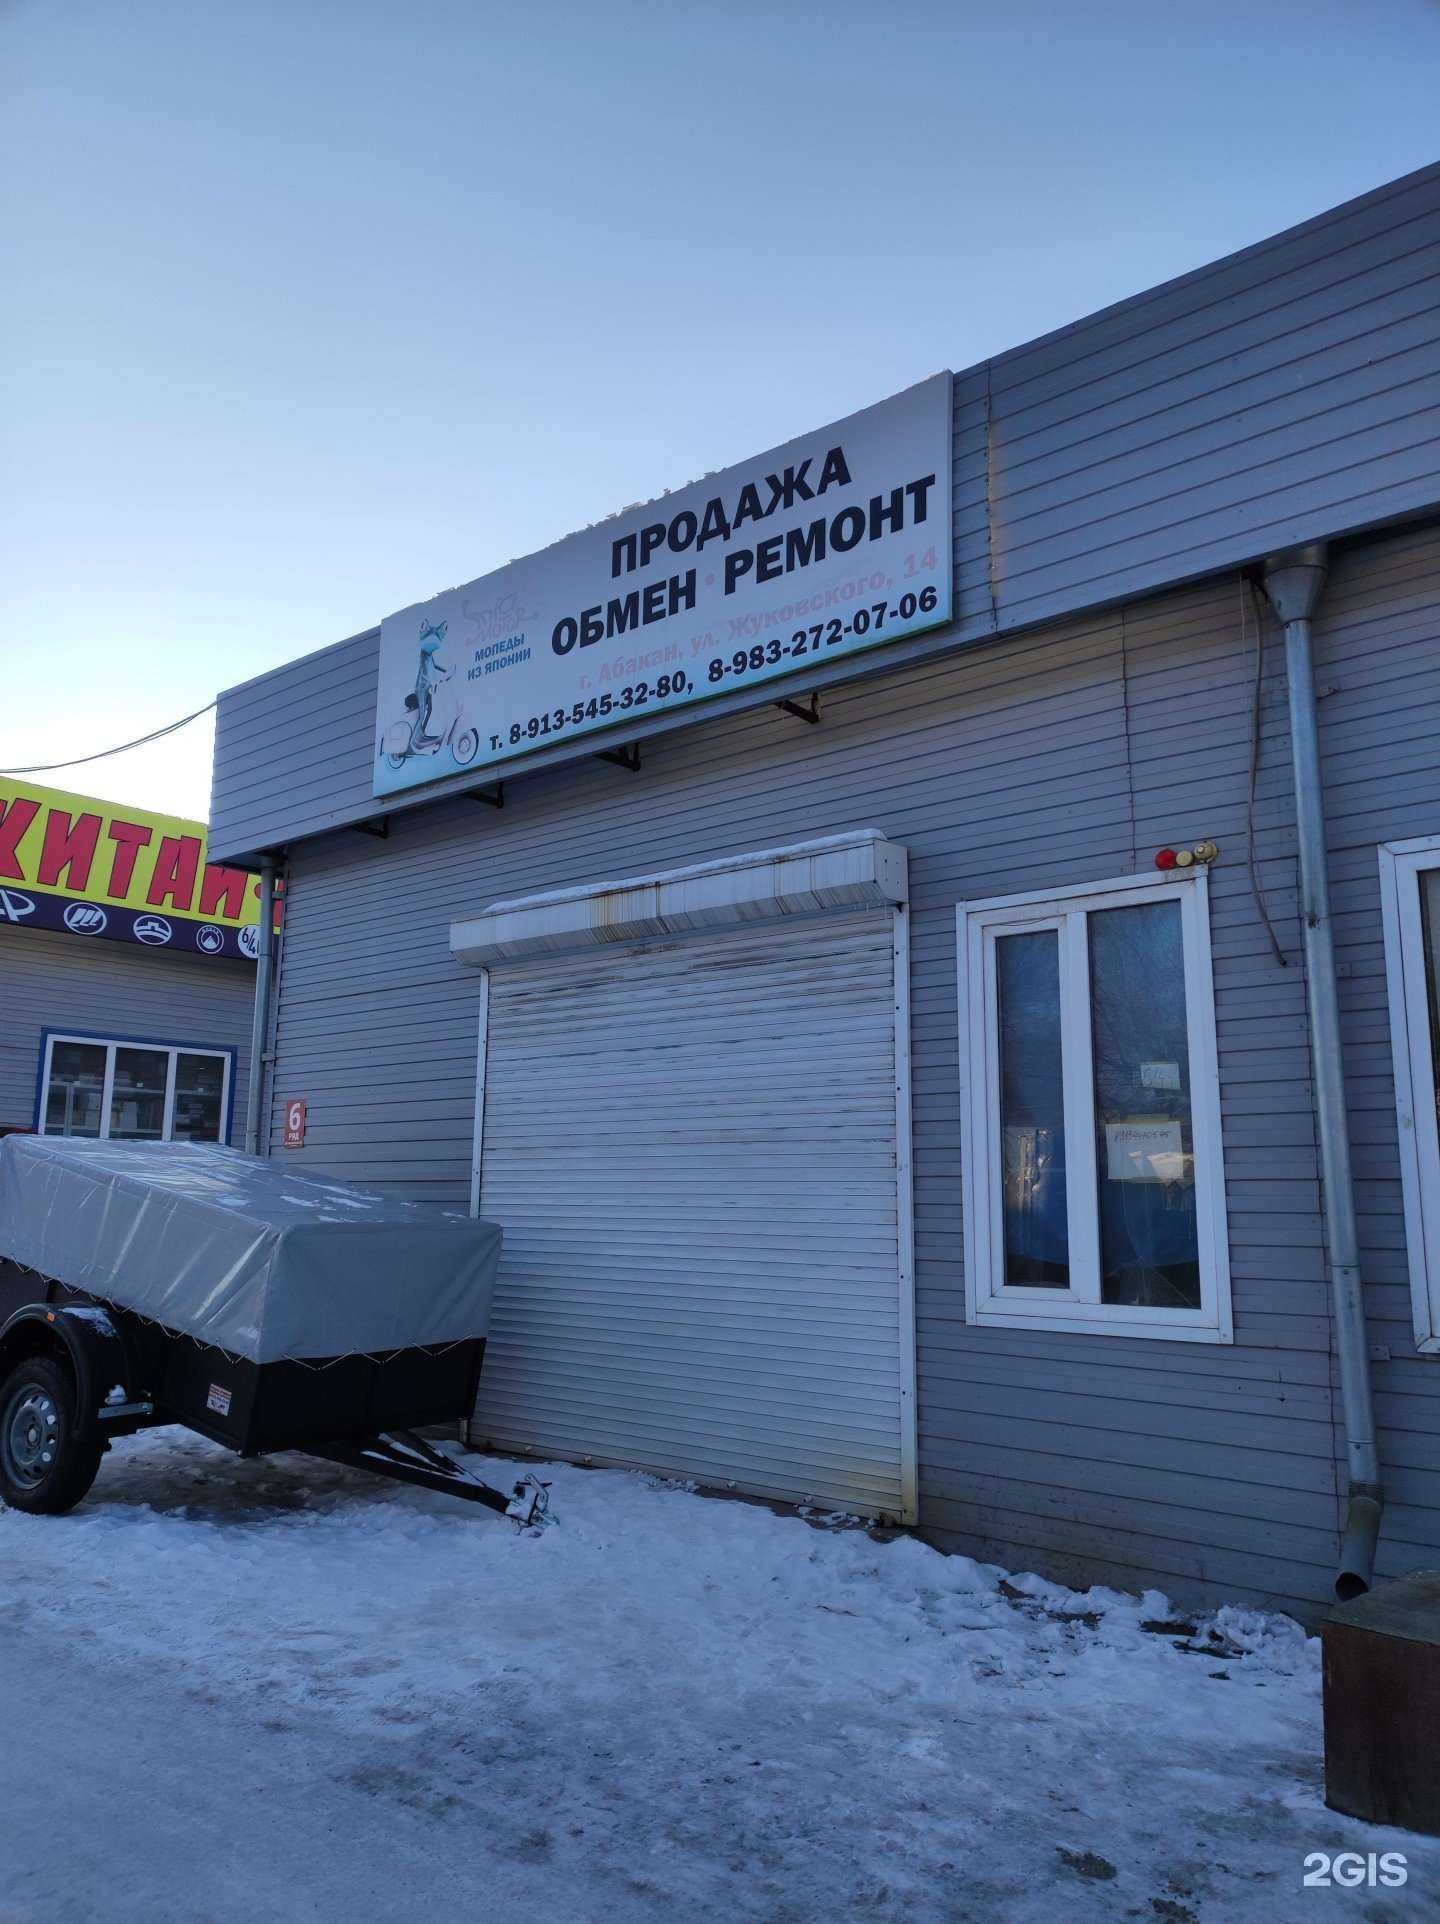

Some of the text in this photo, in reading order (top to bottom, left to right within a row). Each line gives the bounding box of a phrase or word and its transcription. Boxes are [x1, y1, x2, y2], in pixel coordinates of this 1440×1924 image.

[552, 474, 936, 656] ОБМЕН РЕМОНТ
[611, 446, 851, 578] ПРОДАЖА
[467, 647, 531, 681] ИЗ ЯПОНИИ
[474, 633, 525, 662] МОПЕДЫ
[490, 586, 938, 751] т. 8-913-545-32-80, 8-983-272-07-06
[599, 643, 684, 684] Абакан,
[690, 628, 720, 658] ул.
[727, 569, 894, 641] Жуковского,
[903, 546, 939, 580] 14
[289, 1102, 301, 1131] 6
